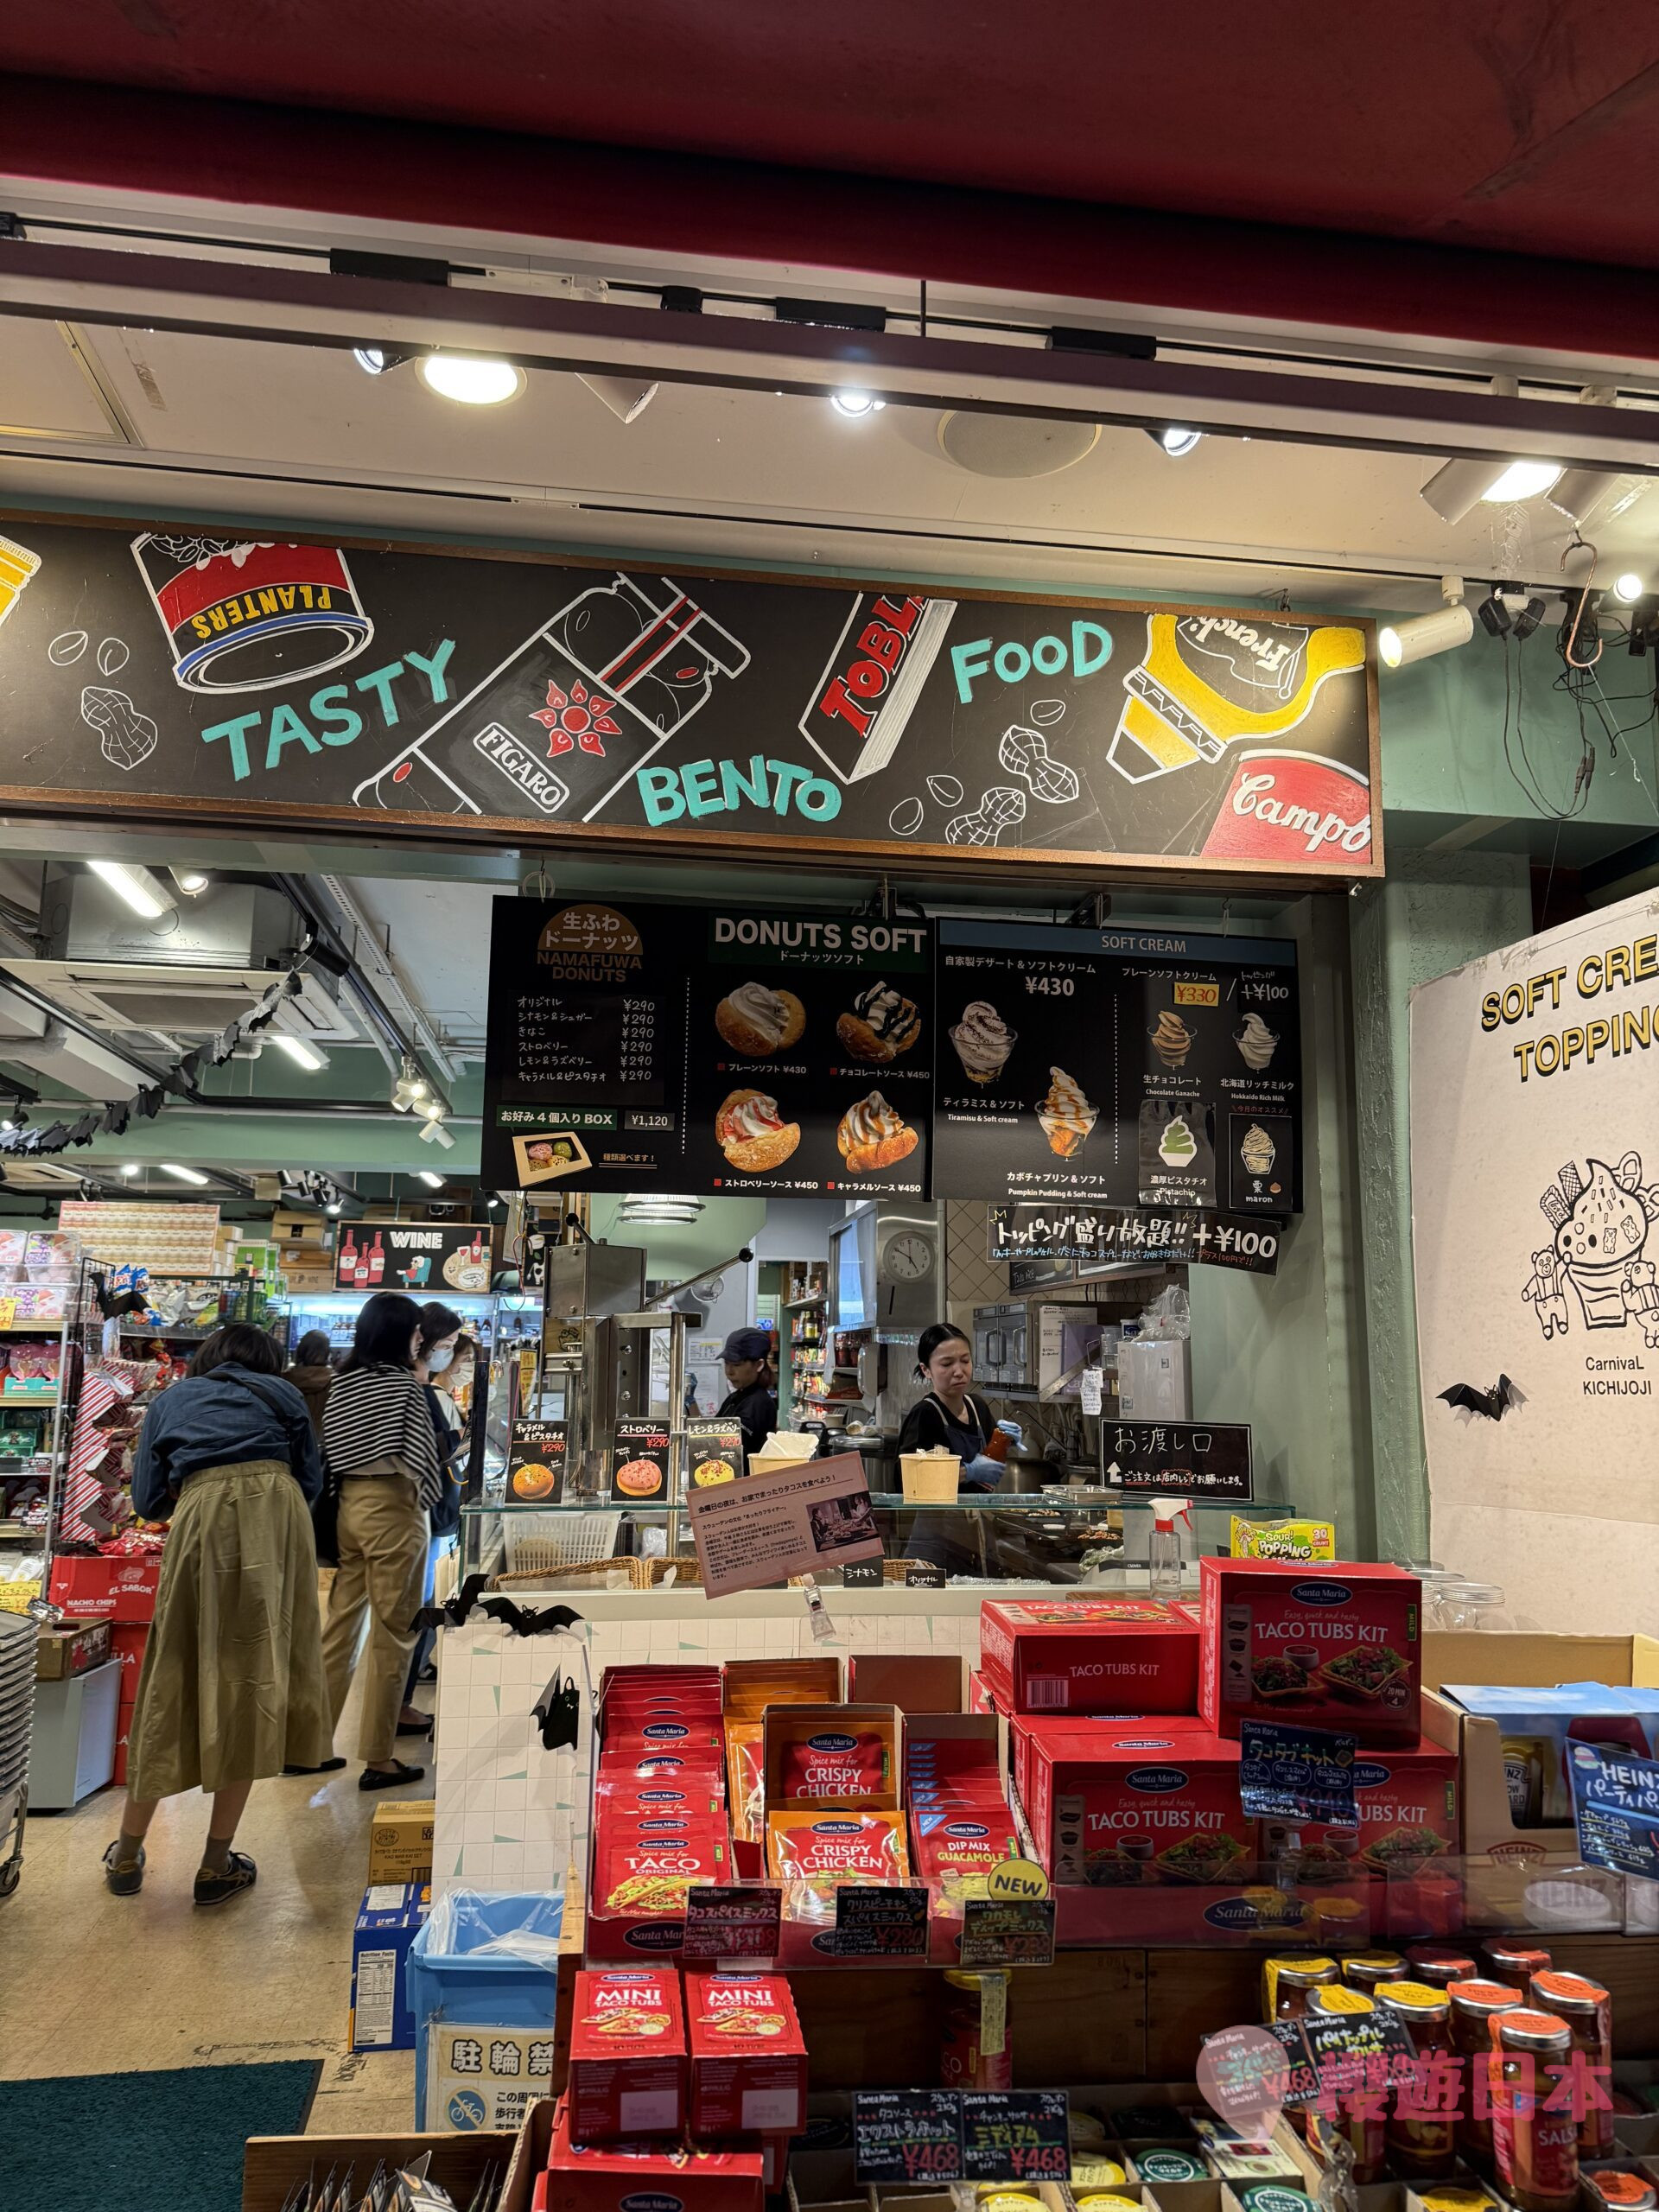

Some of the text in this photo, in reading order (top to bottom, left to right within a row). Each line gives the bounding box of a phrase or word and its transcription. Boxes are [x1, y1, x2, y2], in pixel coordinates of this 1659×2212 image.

[193, 584, 334, 639] PLANTERS
[819, 596, 926, 737] TOBL
[950, 620, 1114, 704] FOOD
[201, 639, 456, 783] TASTY
[477, 722, 567, 813] FIGARO
[637, 754, 842, 827] BENTO
[563, 912, 620, 931] 生ふわ
[546, 929, 639, 951] ドーナッツ
[715, 917, 927, 953] DONUTS SOFT
[1102, 935, 1186, 952] SOFT CREAM
[537, 951, 643, 969] NAMAFUWA
[779, 950, 864, 965] ドーナッツソフト
[552, 966, 626, 982] DONUTS
[1025, 976, 1075, 996] ¥430
[1481, 933, 1659, 1033] SOFT CRE
[1177, 984, 1217, 1003] ¥330
[517, 995, 655, 1012] オリジナル ¥290
[622, 1014, 654, 1025] ¥290
[518, 1026, 654, 1039] きなこ ¥290
[518, 1041, 652, 1052] ストロベリー ¥290
[1513, 1005, 1659, 1084] TOPPIN
[620, 1056, 652, 1067] ¥290
[783, 1065, 807, 1074] ¥430
[839, 1067, 930, 1079] チョコレートソース ¥450
[620, 1071, 652, 1082] ¥290
[1142, 1074, 1202, 1086] 生チョコレート
[1220, 1077, 1294, 1090] 北海道リッチミルク
[584, 1114, 613, 1125] BOX
[632, 1115, 668, 1127] ¥1,120
[947, 1113, 976, 1122] Tiramisu
[725, 1179, 818, 1190] ストロベリーソース ¥450
[837, 1182, 921, 1192] キャラメルソース ¥450
[1007, 1188, 1038, 1198] Pumpkin
[1039, 1189, 1066, 1198] Pudding
[1072, 1190, 1087, 1198] Soft
[390, 1231, 442, 1249] WINE
[1583, 1380, 1652, 1395] KICHIJOJI
[620, 1424, 664, 1434] ストロベリー
[646, 1437, 670, 1447] ¥290
[720, 1437, 741, 1447] ¥290
[1115, 1427, 1212, 1455] お渡し口
[541, 1443, 565, 1453] ¥290
[1265, 1529, 1294, 1541] SOUR!
[1313, 1528, 1327, 1540] 30
[1259, 1540, 1312, 1558] POPPING
[109, 1584, 153, 1595] EL SABOR
[1296, 1587, 1346, 1599] Santa Maria
[1325, 1611, 1338, 1619] and
[1255, 1622, 1389, 1643] TACO TUBS KIT
[1069, 1663, 1160, 1678] TACO TUBS KIT
[647, 1727, 664, 1736] Santa
[809, 1754, 858, 1766] Spice mix for
[804, 1767, 863, 1783] CRISPY
[1131, 1774, 1183, 1783] Santa Maria
[1360, 1768, 1385, 1778] Maria
[795, 1783, 872, 1799] CHICKEN
[639, 1802, 658, 1811] Spice
[1139, 1798, 1196, 1809] quick and tasty
[1087, 1810, 1225, 1831] TACO TUBS KIT
[1357, 1804, 1394, 1822] UBS
[1396, 1806, 1427, 1824] KIT
[810, 1845, 871, 1857] CRISPY
[947, 1841, 990, 1853] DIP MIX
[803, 1856, 883, 1870] CHICKEN
[937, 1852, 1005, 1863] GUACAMOLE
[624, 1858, 701, 1871] TACO
[995, 1874, 1043, 1897] NEW
[842, 1911, 914, 1925] スパイスミックス
[596, 1989, 662, 2001] MINI
[708, 1989, 772, 2001] MINI
[451, 2037, 555, 2075] 駐輪禁
[857, 2095, 879, 2105] Santa
[963, 2094, 1009, 2106] Santa Maria
[1538, 2130, 1578, 2146] SALS
[902, 2144, 961, 2179] ¥468
[1009, 2147, 1067, 2177] ¥468
